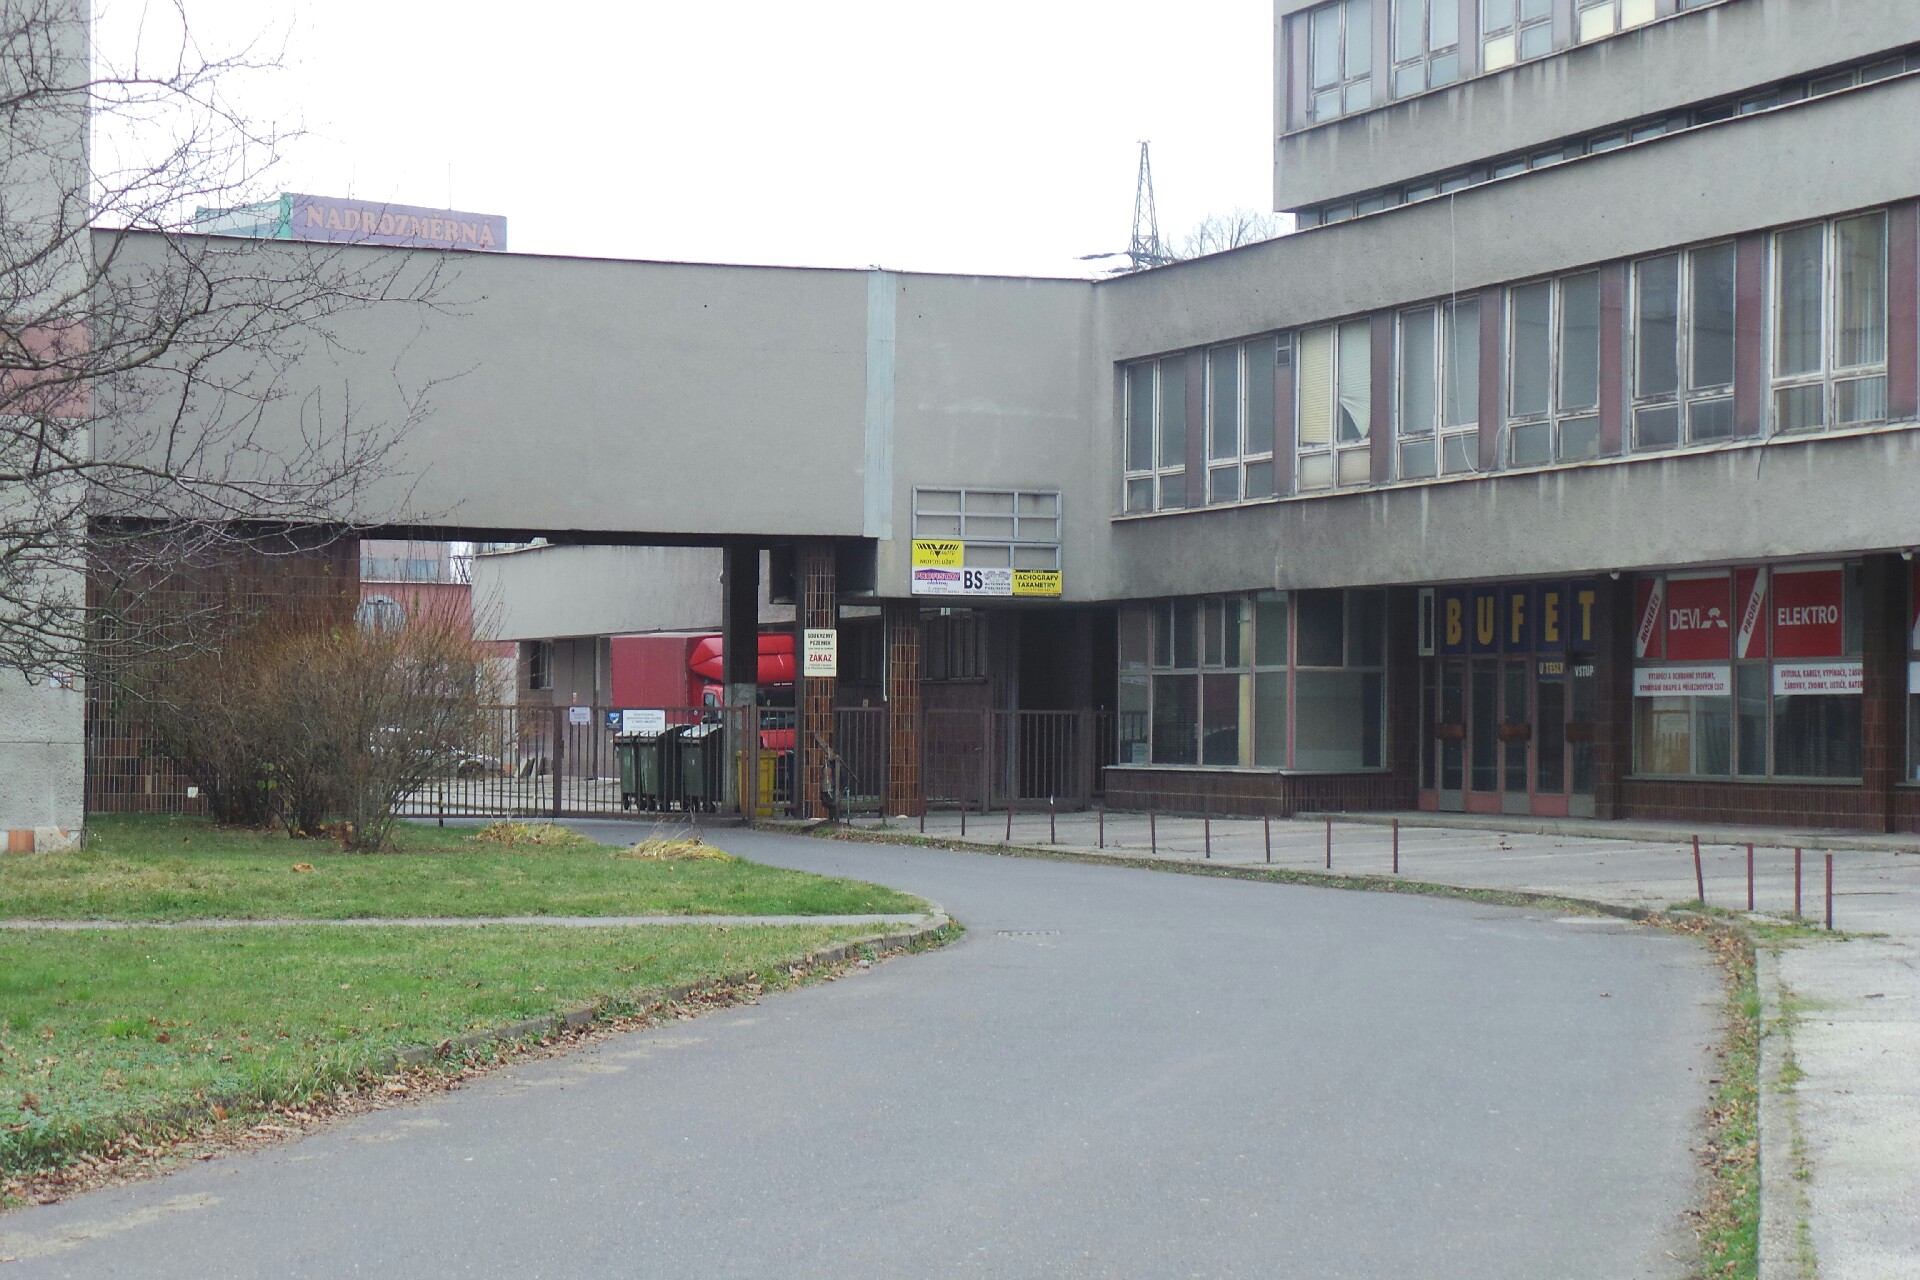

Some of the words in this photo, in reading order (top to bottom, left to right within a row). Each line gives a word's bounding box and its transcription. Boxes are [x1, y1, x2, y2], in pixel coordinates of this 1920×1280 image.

[305, 204, 496, 246] NADROZMĚRNÁ
[963, 570, 983, 590] BS
[1446, 590, 1596, 646] BUFET
[1743, 592, 1760, 635] PRODEJ
[1777, 604, 1838, 626] ELEKTRO
[809, 651, 832, 662] ZÁKAZ
[1574, 664, 1594, 677] VSTUP
